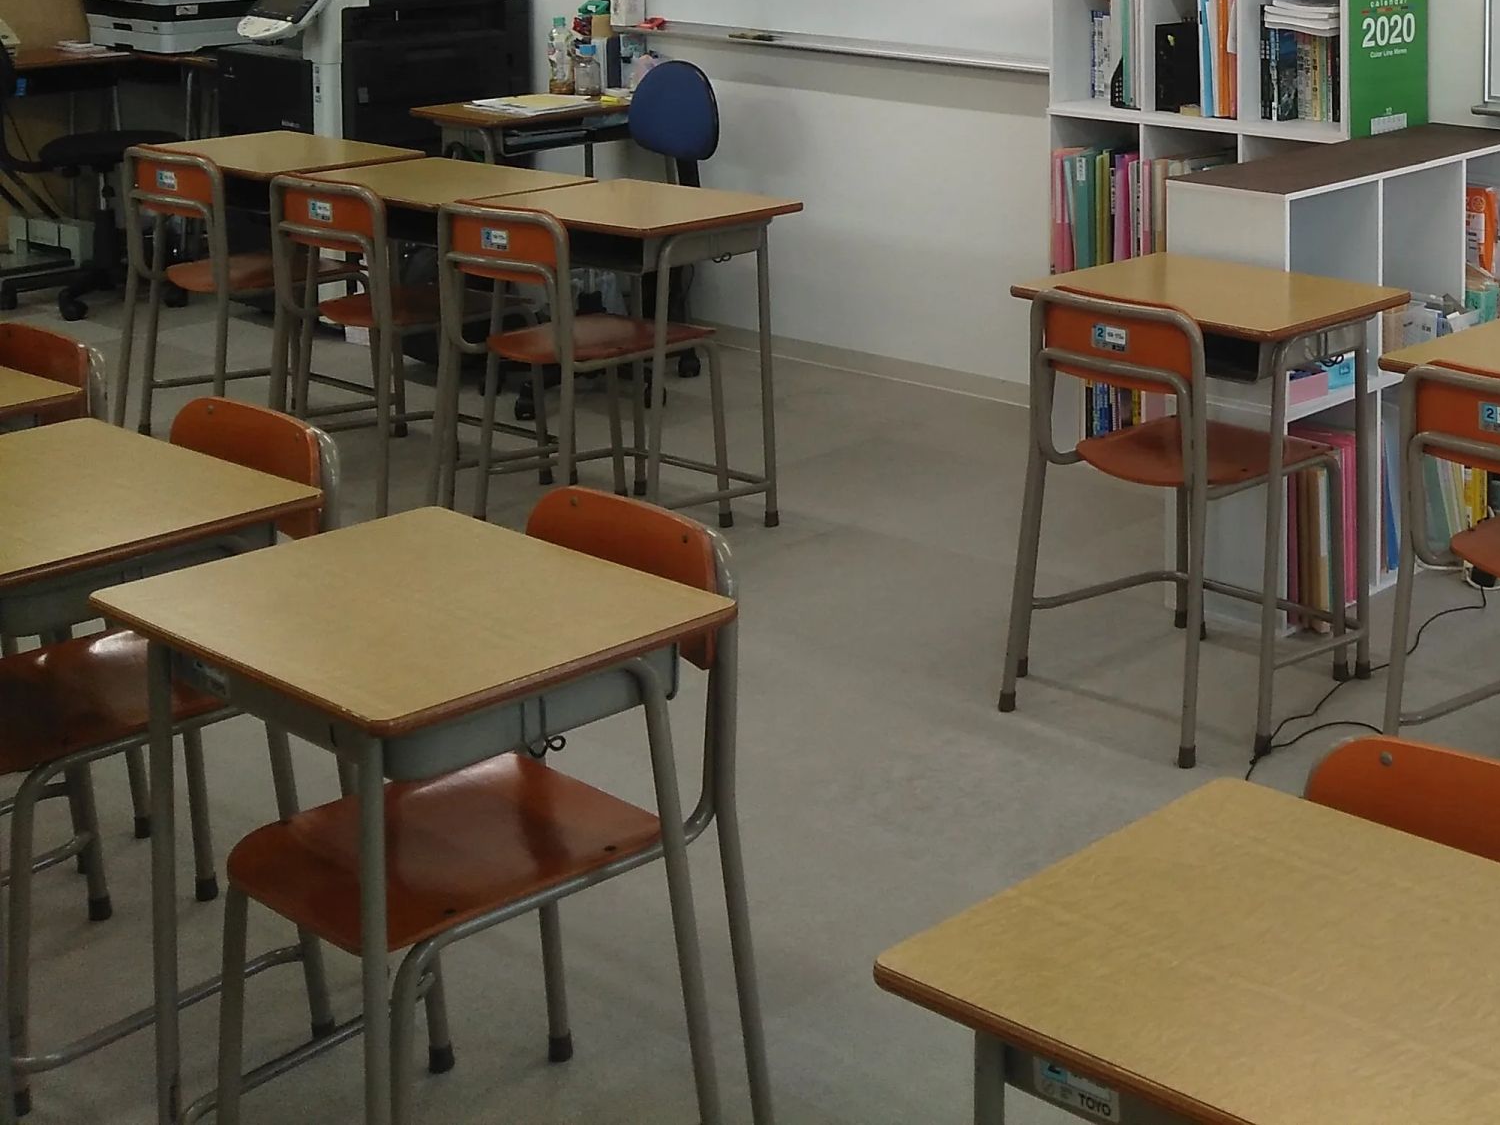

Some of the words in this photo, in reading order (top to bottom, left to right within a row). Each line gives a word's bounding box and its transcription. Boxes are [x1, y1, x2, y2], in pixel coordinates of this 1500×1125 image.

[1361, 12, 1416, 49] 2020
[1097, 327, 1104, 338] 2
[1486, 407, 1495, 420] 2
